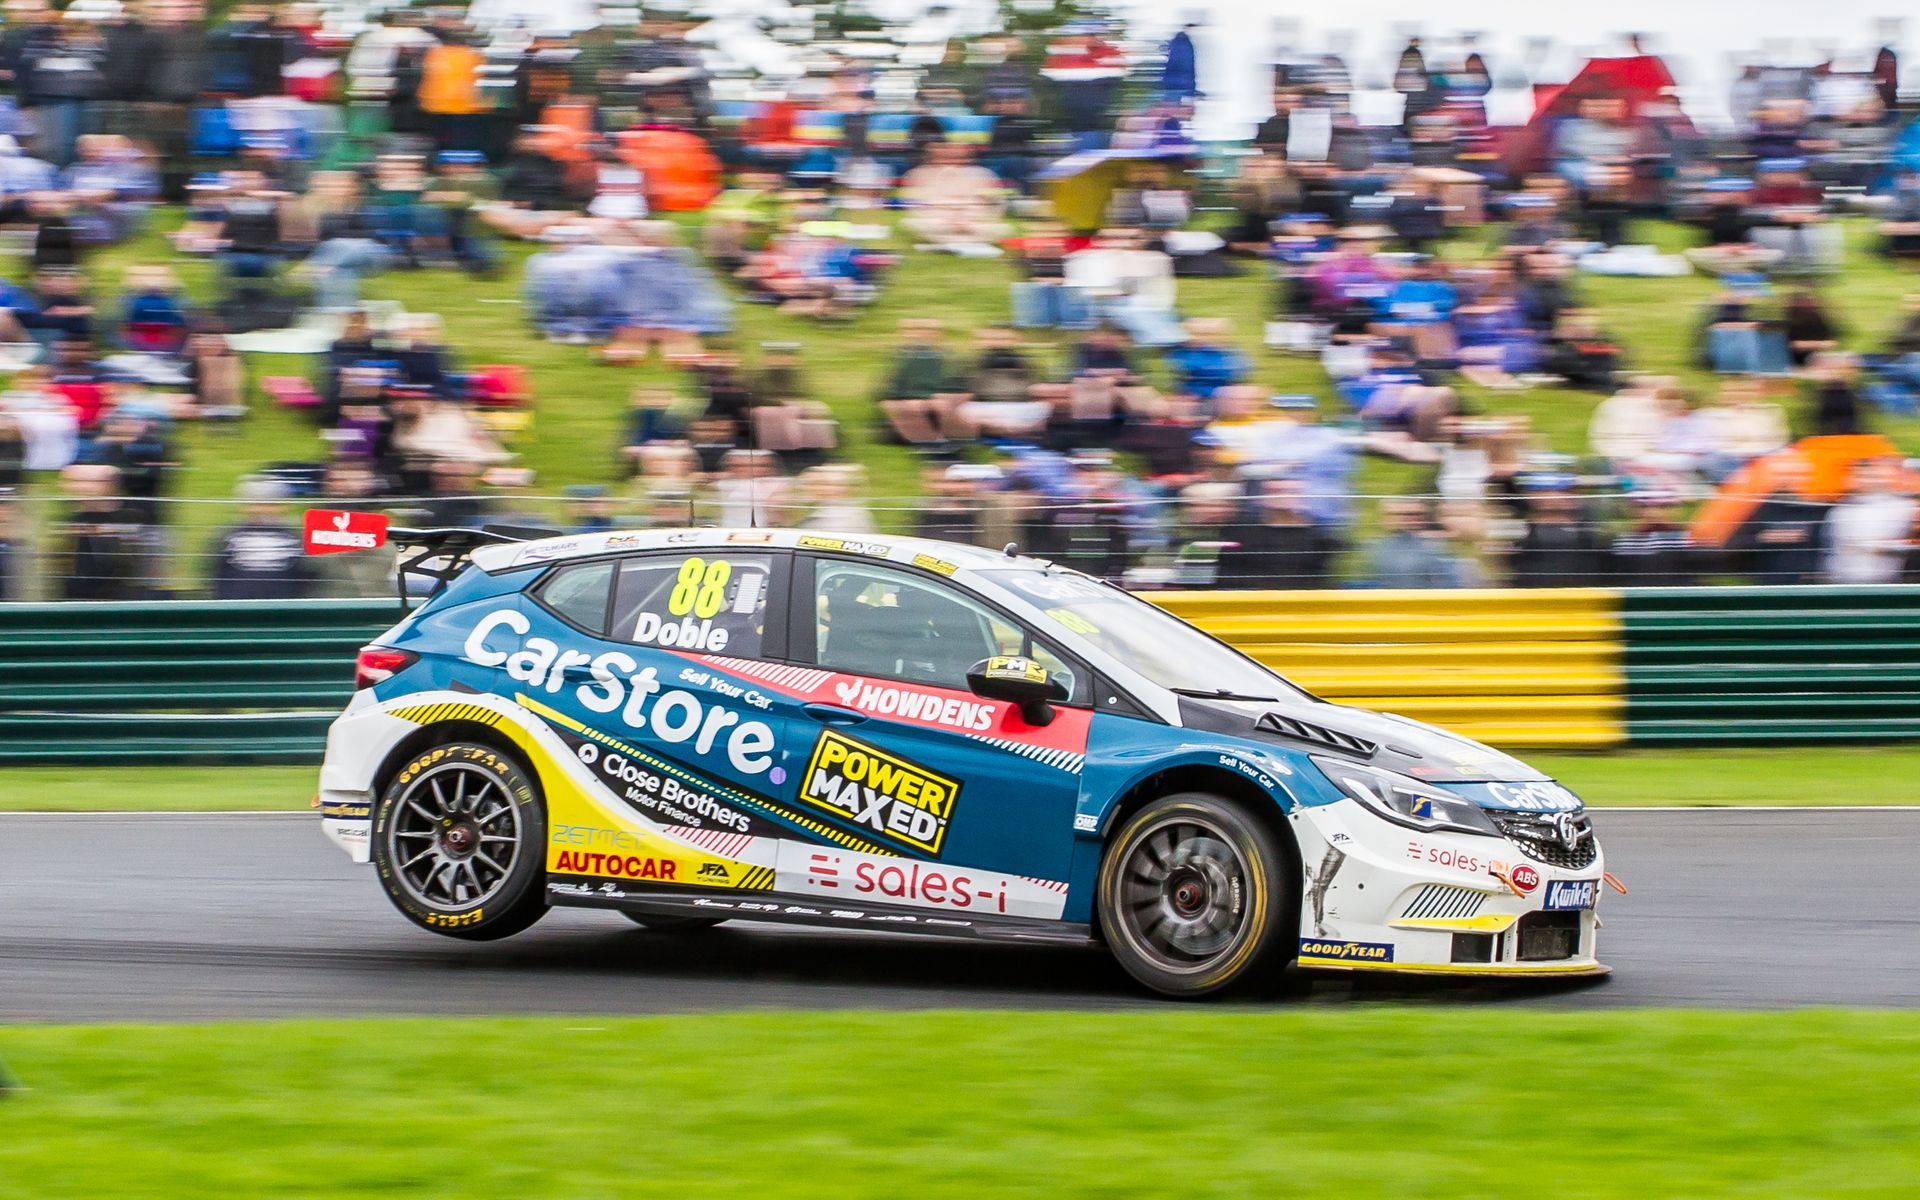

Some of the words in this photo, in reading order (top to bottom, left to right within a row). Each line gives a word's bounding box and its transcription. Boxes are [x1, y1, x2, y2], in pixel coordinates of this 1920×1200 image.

[801, 538, 842, 549] POWER
[842, 541, 889, 554] MAXED
[668, 557, 732, 618] 88
[632, 612, 729, 651] Doble
[679, 668, 711, 686] Sell
[709, 677, 745, 698] Your
[857, 686, 996, 730] HOWDENS
[819, 740, 945, 816] POWER
[1219, 755, 1237, 767] Sell
[1239, 761, 1259, 778] Your
[603, 753, 661, 792] Close
[661, 778, 751, 832] Brothers
[625, 786, 658, 809] Motor
[658, 801, 701, 827] Finance
[809, 768, 938, 841] MAXED
[556, 851, 676, 879] AUTOCAR
[697, 863, 729, 877] JFA
[1515, 870, 1538, 885] ABS
[855, 862, 1007, 913] sales-i
[1301, 942, 1386, 958] GOODYEAR
